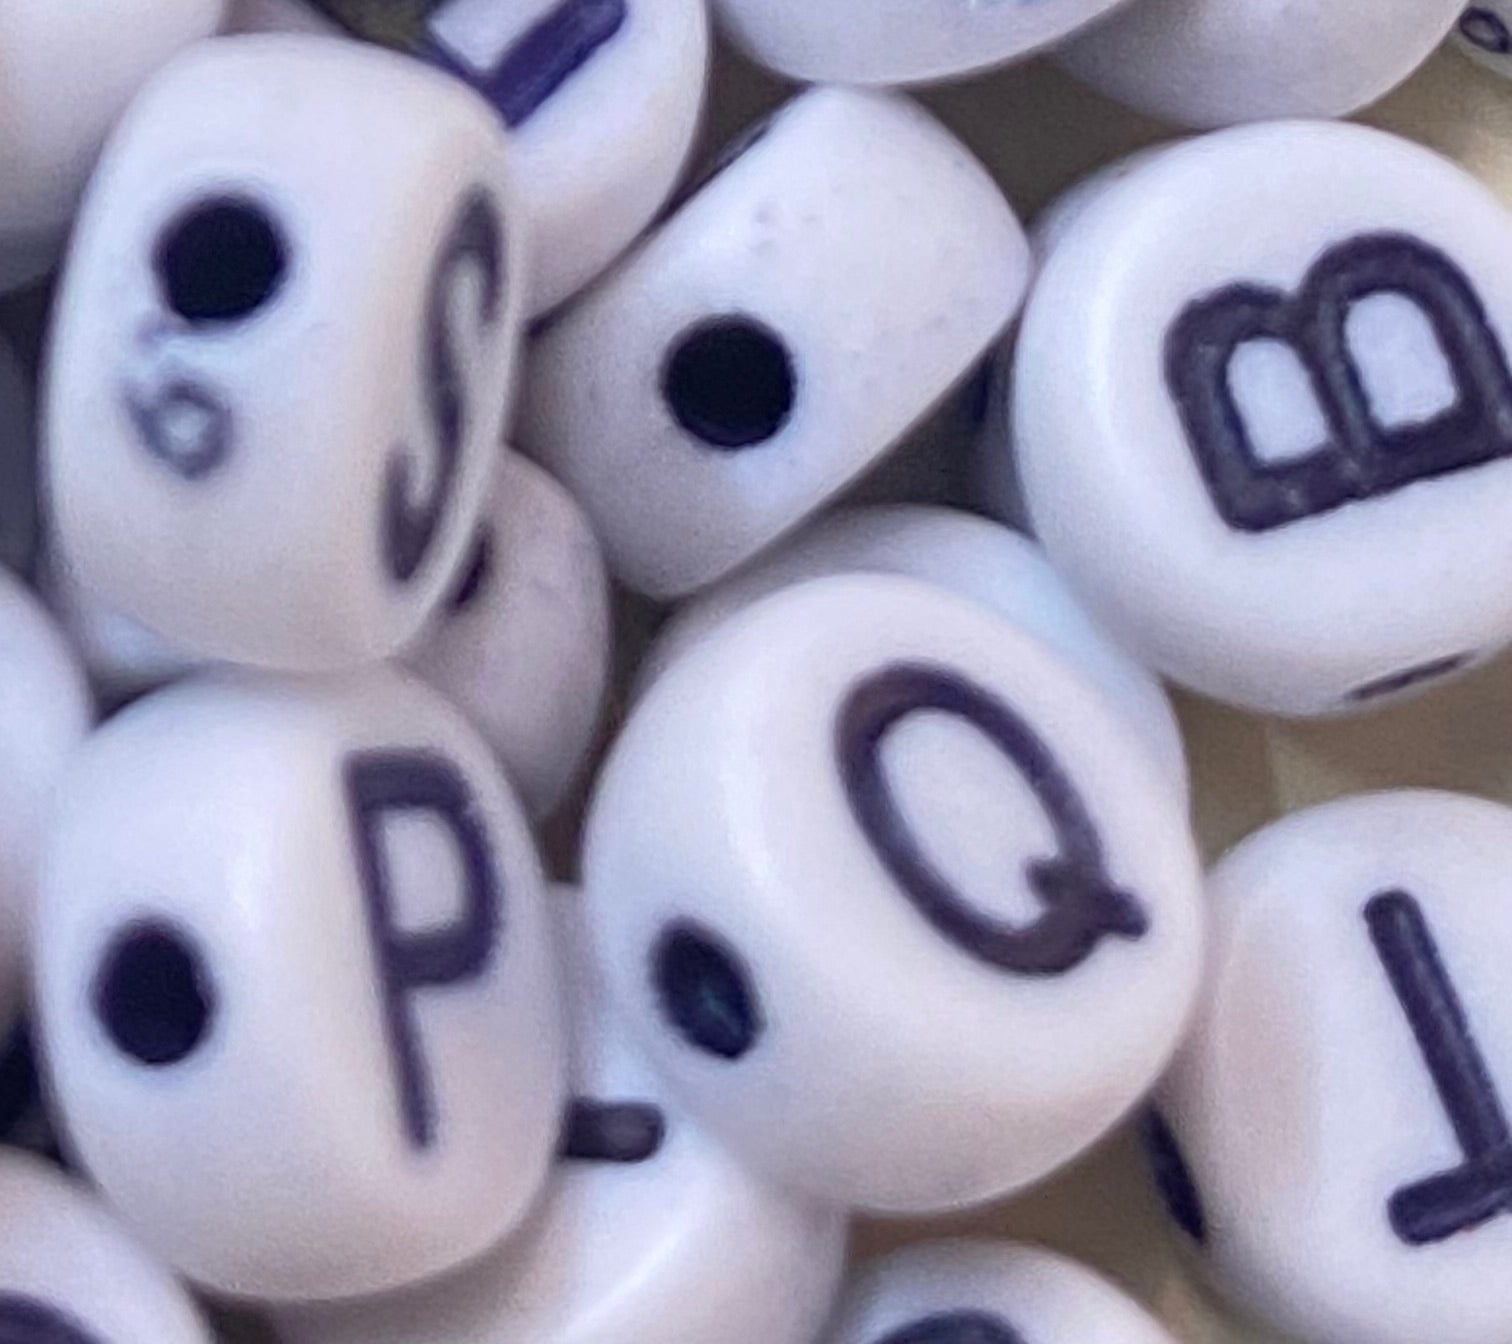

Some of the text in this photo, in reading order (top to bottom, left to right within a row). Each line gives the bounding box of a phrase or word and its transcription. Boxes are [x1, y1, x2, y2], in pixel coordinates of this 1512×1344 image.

[378, 182, 506, 582] S
[1162, 228, 1512, 534] B
[343, 746, 506, 1152] P
[833, 658, 1150, 978] Q
